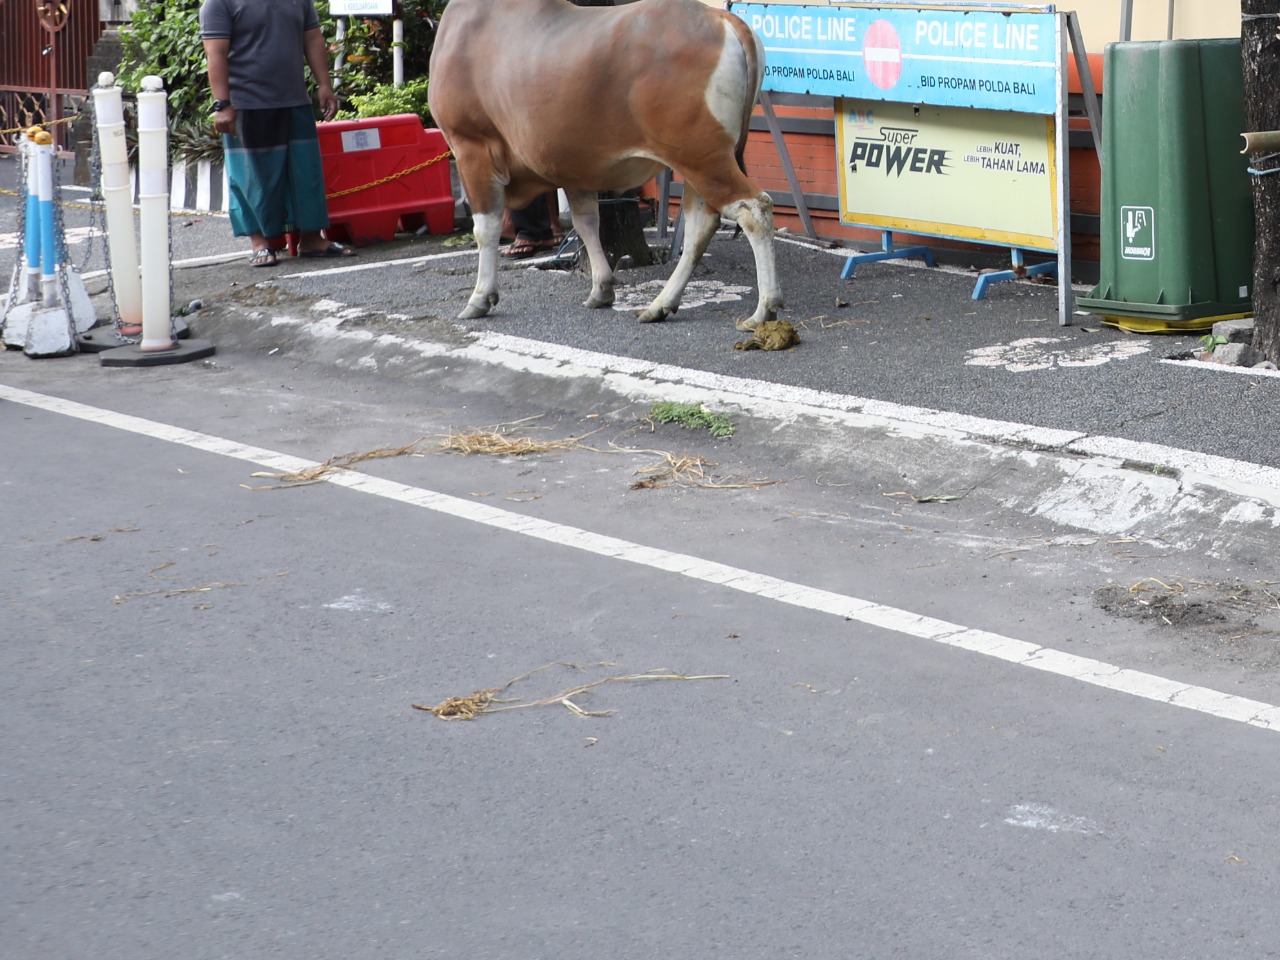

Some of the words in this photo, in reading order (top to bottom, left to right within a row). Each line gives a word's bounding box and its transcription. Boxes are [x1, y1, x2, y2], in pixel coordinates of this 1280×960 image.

[752, 14, 812, 39] POLICE
[818, 17, 856, 41] LINE
[916, 20, 987, 48] POLICE
[993, 23, 1039, 50] LINE
[772, 66, 805, 79] PROPAM
[807, 69, 834, 81] POLDA
[836, 71, 855, 82] BALI
[920, 75, 936, 88] BID
[938, 76, 976, 90] PROPAM
[980, 80, 1011, 93] POLDA
[1014, 82, 1036, 95] BALI
[848, 110, 874, 124] ABC
[866, 127, 919, 145] Super
[850, 142, 951, 178] POWER
[976, 145, 992, 154] LEBIH
[994, 142, 1021, 158] KUAT,
[964, 155, 980, 163] LEBIH
[981, 157, 1013, 171] TAHAN
[1016, 161, 1046, 175] LAMA
